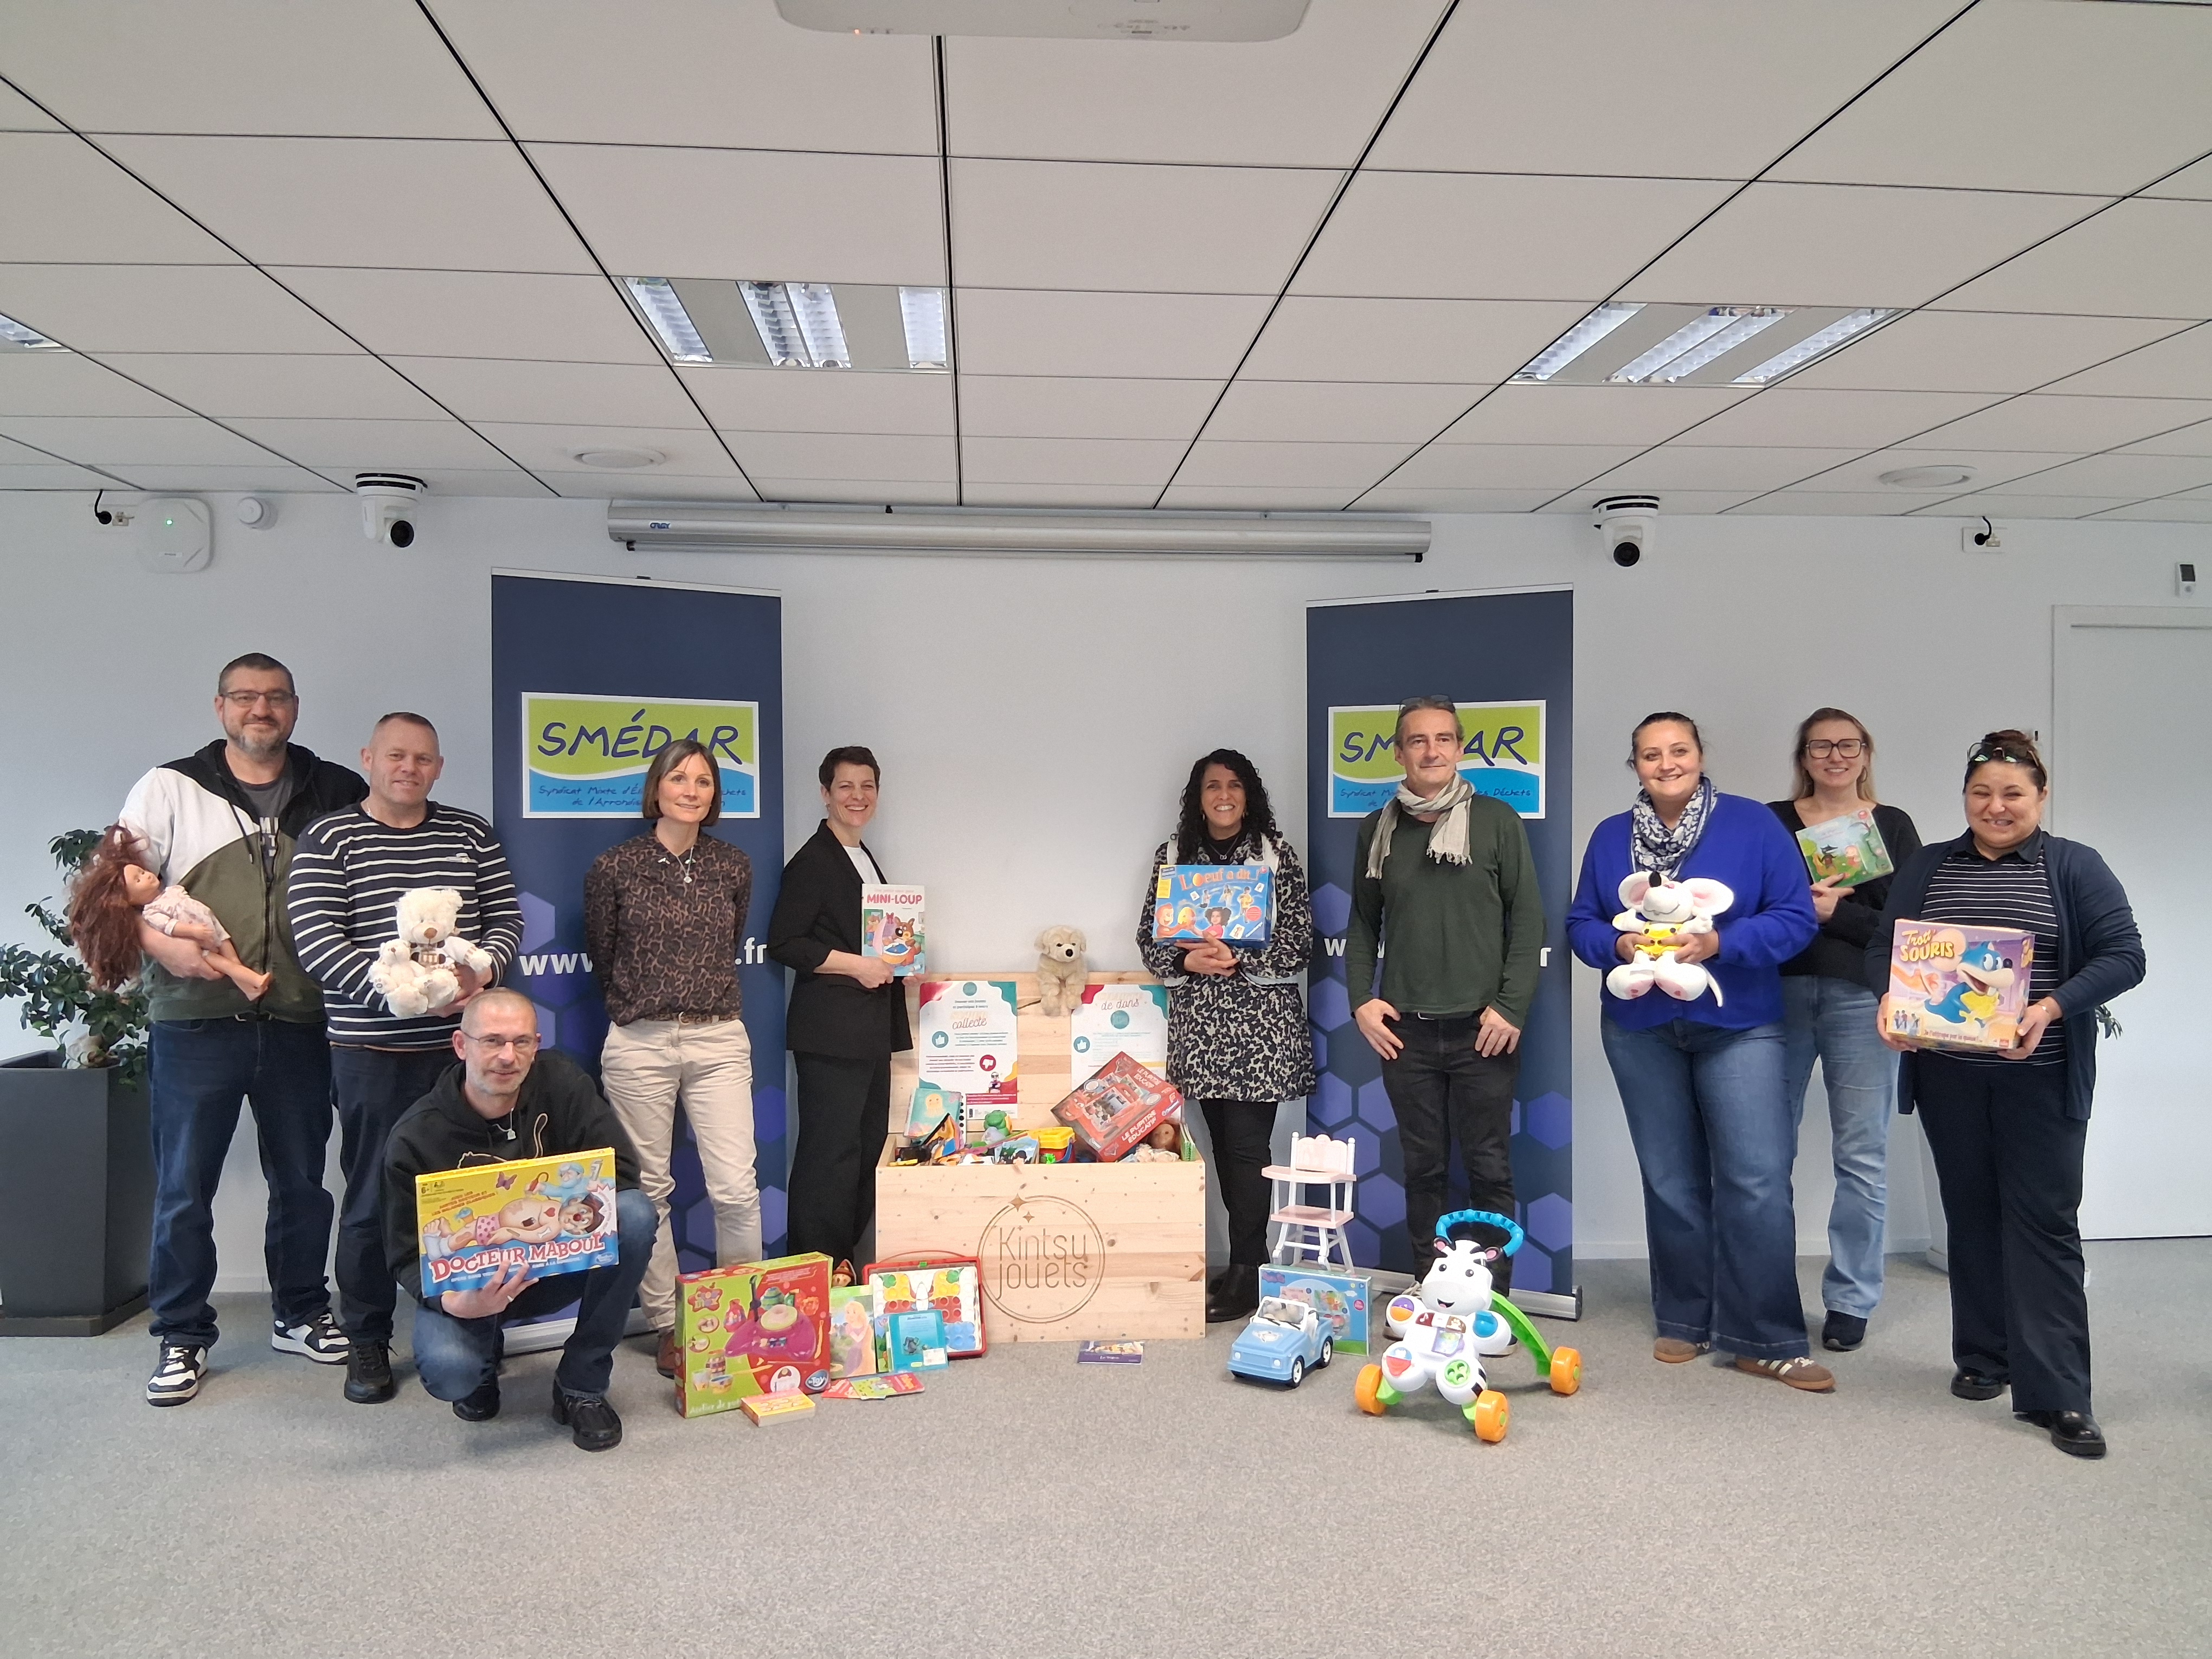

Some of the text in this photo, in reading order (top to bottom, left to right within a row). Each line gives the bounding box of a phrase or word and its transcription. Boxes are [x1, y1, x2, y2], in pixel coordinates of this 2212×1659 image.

[1340, 726, 1528, 766] SMAR
[539, 786, 582, 796] Syndicat
[1493, 787, 1531, 796] Déchets
[867, 893, 922, 904] MINI-LOUP
[1900, 942, 1953, 961] SOURIS
[952, 1017, 987, 1030] collecte
[999, 1226, 1086, 1261] Kintsu
[430, 1233, 605, 1281] DOCTEUR MABOUL
[995, 1262, 1086, 1301] jouets
